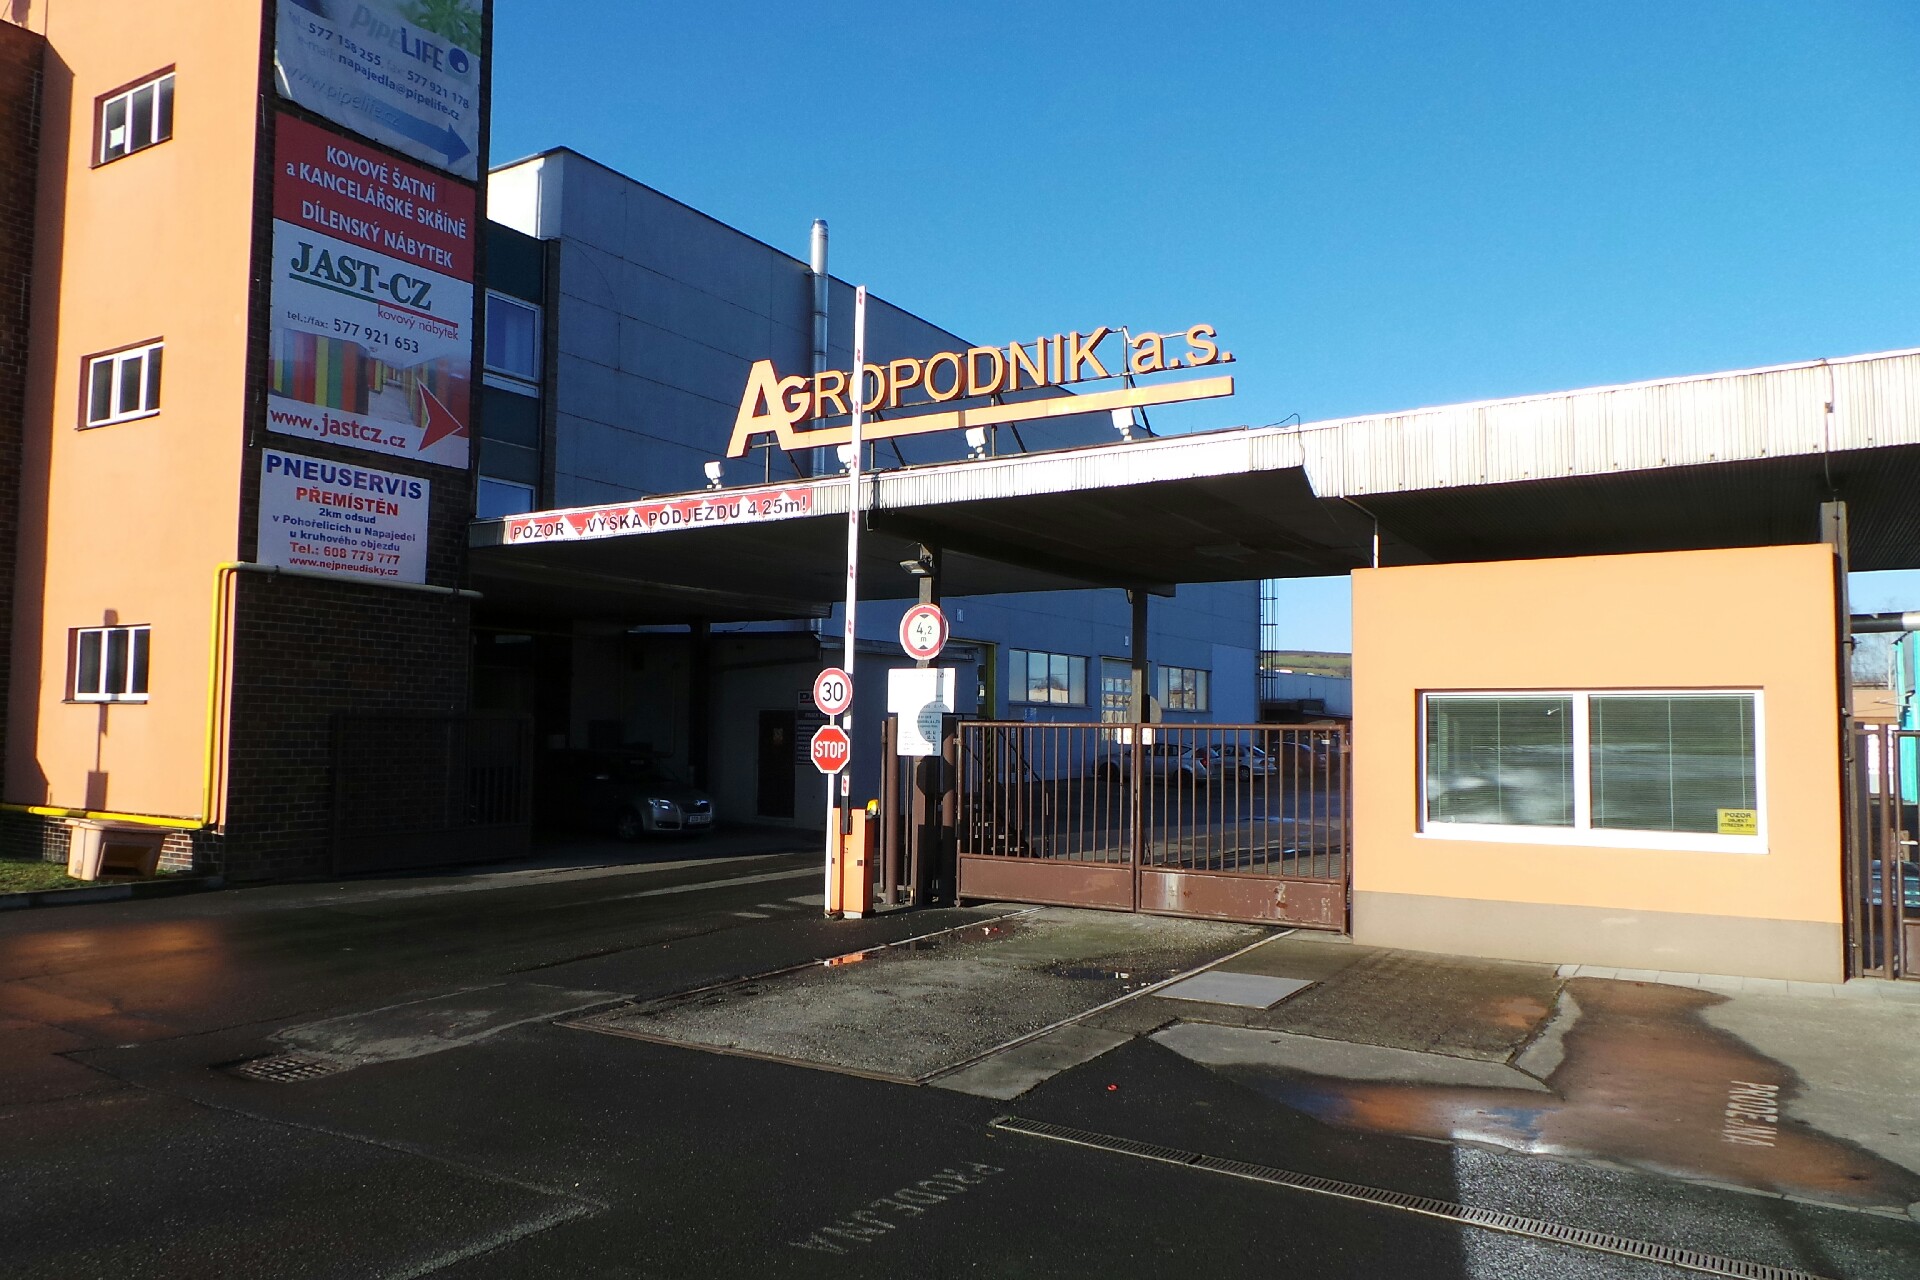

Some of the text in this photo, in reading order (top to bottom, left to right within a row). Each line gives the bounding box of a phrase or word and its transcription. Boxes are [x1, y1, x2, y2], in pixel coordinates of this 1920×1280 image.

[308, 22, 333, 41] 577
[338, 34, 357, 54] 158
[407, 70, 427, 87] 577
[429, 81, 448, 98] 921
[452, 91, 470, 109] 178
[338, 55, 460, 121] napajedla@pipelife.cz
[327, 145, 436, 202] KOVOVÉ ŠATNÍ
[286, 162, 467, 240] a KANCELÁŘSKÉ SKŘÍNĚ
[302, 200, 453, 269] DÍLENSKÝ NÁBYTEK
[291, 241, 432, 311] JAST-CZ
[334, 318, 359, 337] 577
[365, 327, 389, 346] 921
[395, 336, 419, 354] 653
[378, 308, 459, 341] kovový nábytek
[727, 324, 1235, 458] AGROPODNIK a.s.
[270, 410, 406, 449] www.jastcz.cz
[266, 454, 422, 500] PNEUSERVIS
[296, 486, 399, 517] PŘEMÍSTĚN
[319, 508, 376, 525] 2km odsud
[272, 515, 280, 523] v
[283, 514, 352, 534] Pohořelicích
[354, 527, 361, 535] u
[513, 521, 564, 540] POZOR
[587, 511, 643, 533] VÝŠKA
[649, 503, 741, 529] PODJEZDU
[290, 530, 400, 552] u kruhového objezdu
[290, 541, 400, 565] Tel.: 608 779 777
[289, 556, 399, 576] www.nejpneudisky.cz
[916, 622, 932, 635] 4,2
[822, 682, 844, 702] 30
[815, 740, 846, 758] STOP
[1720, 1080, 1779, 1147] PRODEJNA
